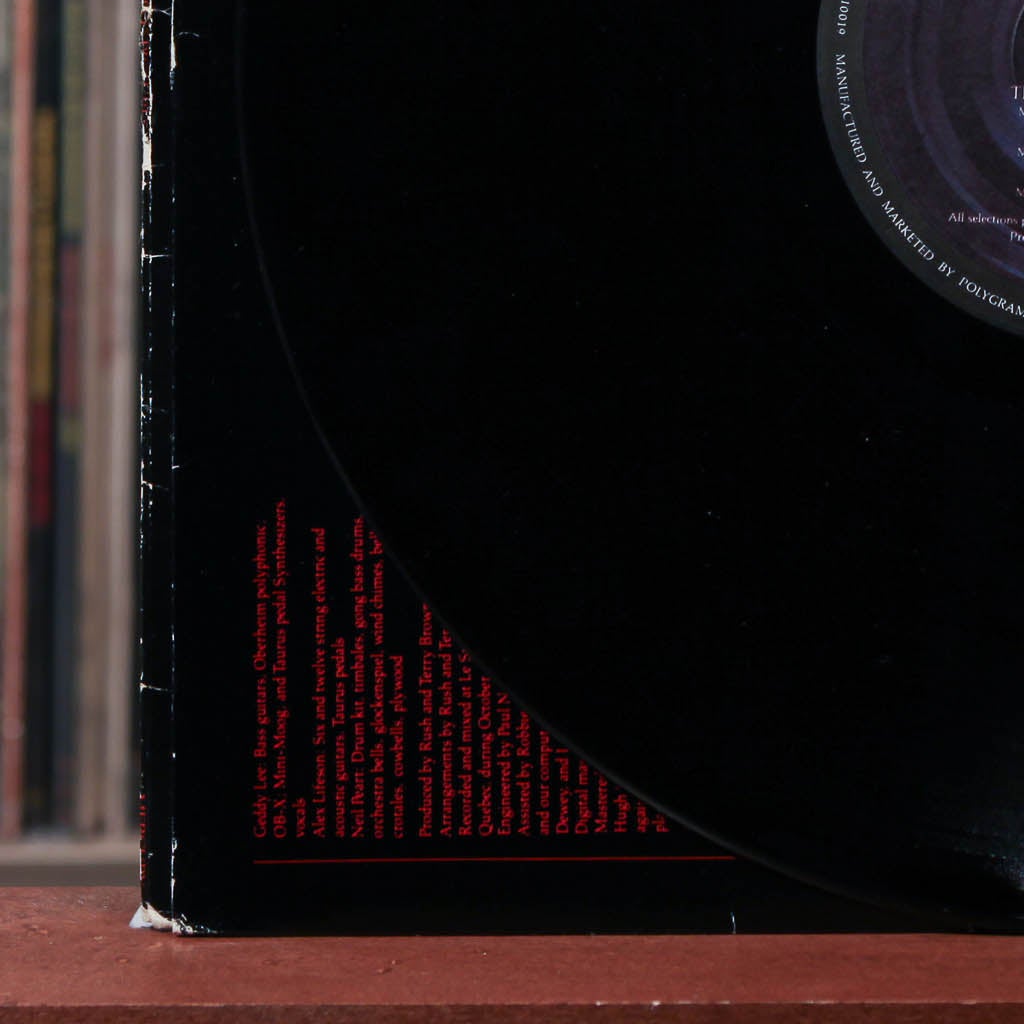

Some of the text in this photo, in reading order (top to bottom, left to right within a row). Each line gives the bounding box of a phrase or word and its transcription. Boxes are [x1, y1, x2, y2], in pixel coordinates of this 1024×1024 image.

[836, 0, 851, 36] 10019
[835, 53, 867, 163] MANUFACTURED
[861, 170, 884, 197] AND
[881, 200, 935, 261] MARKETED
[937, 261, 956, 277] BY
[948, 212, 964, 223] All
[968, 213, 1018, 225] selections
[252, 602, 267, 671] Oberheim
[270, 590, 290, 701] and Taurus pedal
[311, 528, 329, 837] Alex Six and twelve string electric and
[389, 655, 407, 712] plywood
[419, 651, 436, 685] Terry
[436, 653, 452, 678] and
[351, 565, 368, 838] Neil Drum gong bass
[419, 689, 433, 713] and
[438, 681, 452, 716] Rush
[253, 729, 268, 758] Bass
[331, 637, 348, 837] acoustic Taurus pedals
[370, 612, 384, 839] orchestra wind
[418, 717, 433, 751] Rush
[458, 702, 472, 742] mixed
[477, 676, 495, 778] during October
[496, 708, 511, 736] Paul
[458, 746, 472, 771] and
[555, 757, 569, 782] and
[418, 776, 433, 837] Produced
[440, 740, 456, 836] Arrangements
[456, 774, 472, 836] Recorded
[497, 761, 514, 836] Engineered
[514, 781, 531, 835] Assisted
[536, 785, 550, 835] and our
[253, 796, 269, 838] Geddy
[292, 798, 306, 837] vocals
[574, 789, 592, 834] Digital
[613, 794, 631, 832] Hugh
